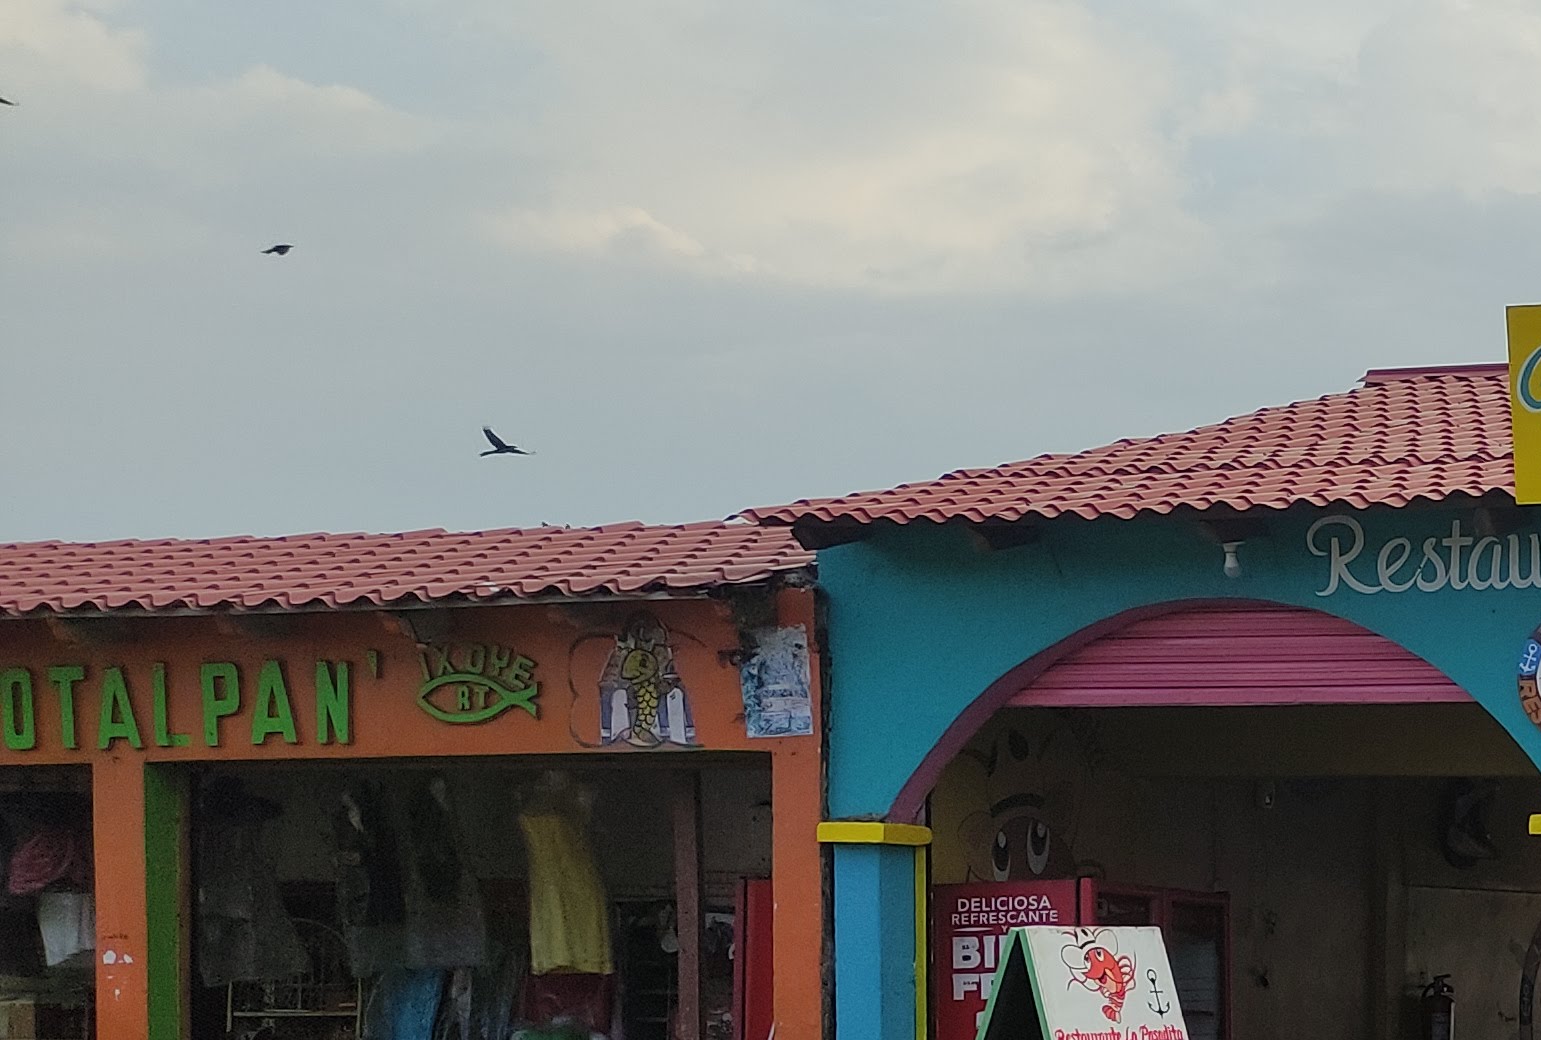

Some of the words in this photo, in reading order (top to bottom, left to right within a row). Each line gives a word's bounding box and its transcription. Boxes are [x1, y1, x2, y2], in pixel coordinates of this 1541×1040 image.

[957, 895, 1051, 912] DELICIOSA
[951, 910, 1059, 925] REFRESCANTE
[1001, 925, 1009, 933] Y
